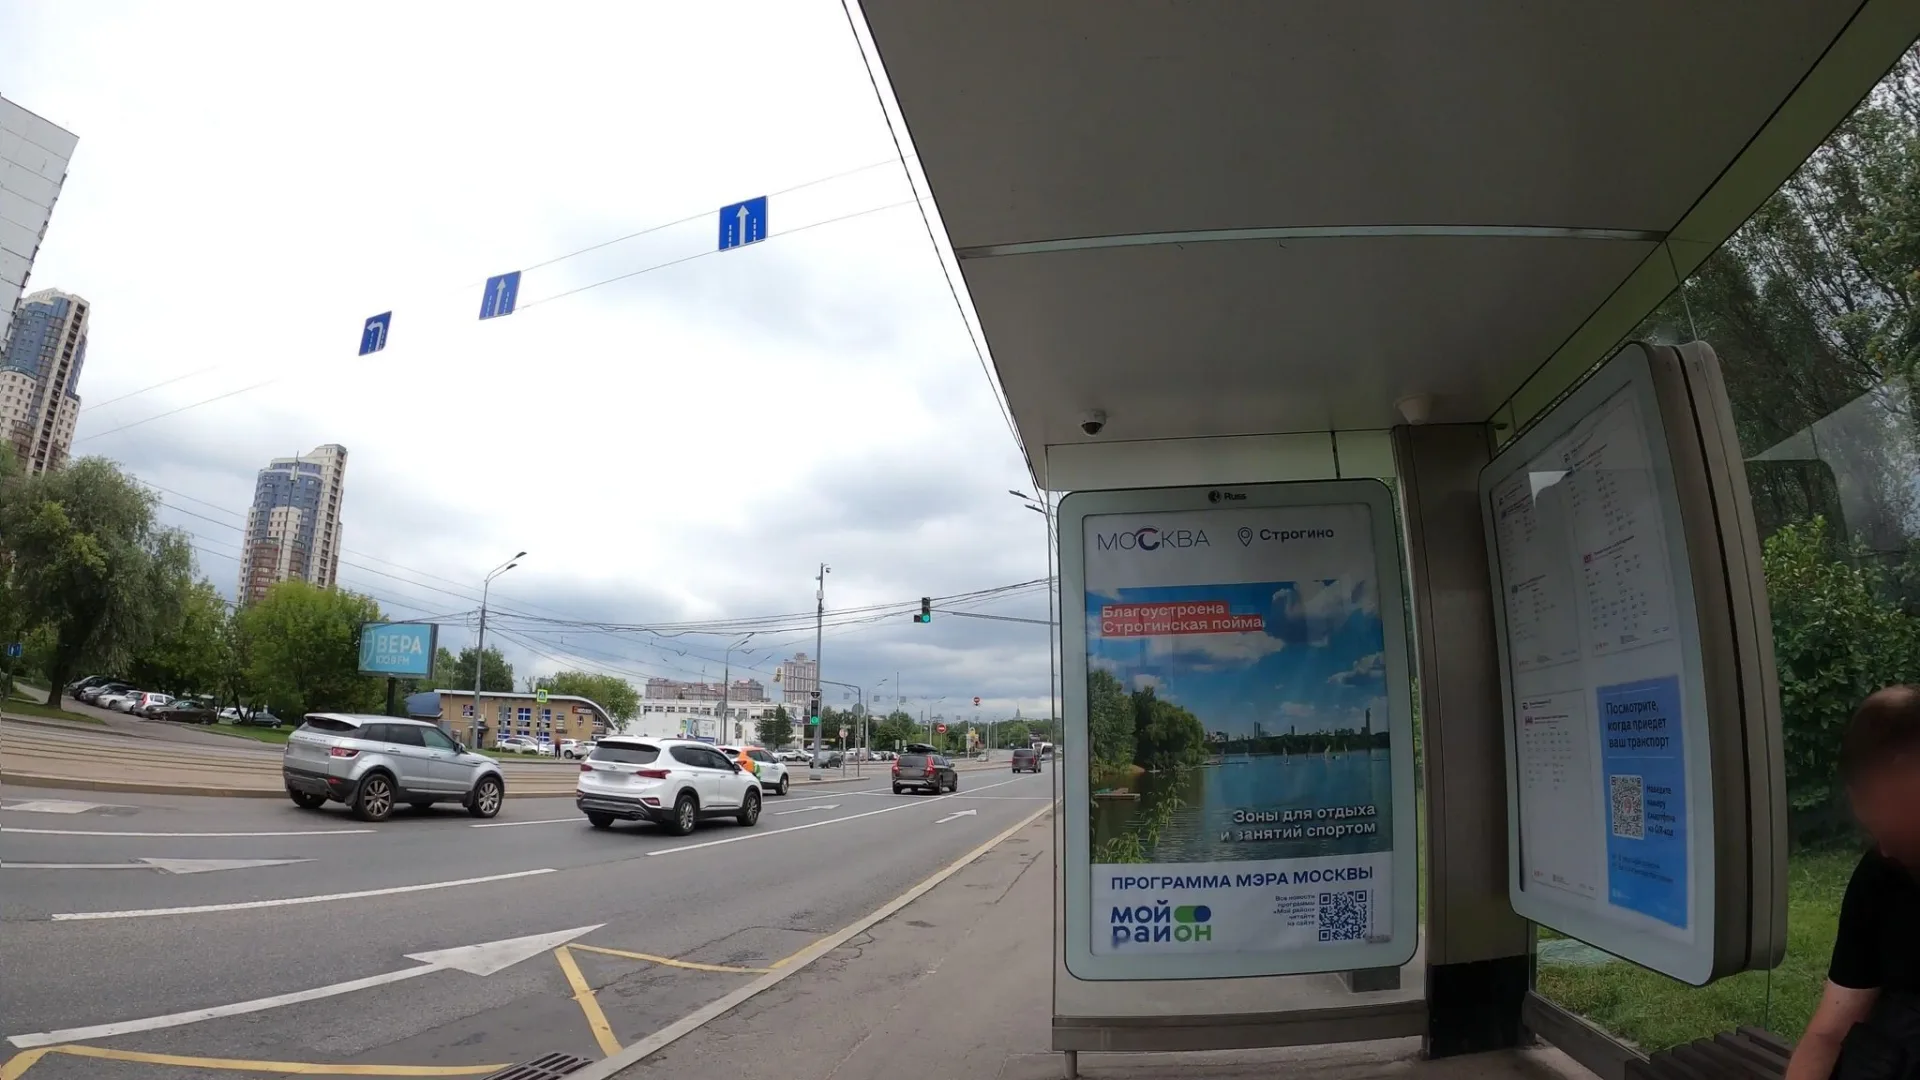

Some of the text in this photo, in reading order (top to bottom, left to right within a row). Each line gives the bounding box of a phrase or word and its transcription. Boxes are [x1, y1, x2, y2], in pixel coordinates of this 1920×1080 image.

[1097, 527, 1211, 551] МОСКВА
[1259, 529, 1334, 542] Строгино
[1102, 604, 1225, 619] Благоустроена
[1102, 619, 1208, 635] Строгинская
[377, 634, 422, 654] ВЕРА
[1605, 701, 1659, 715] Посмотрите,
[1607, 718, 1667, 732] когда приедет
[1609, 736, 1670, 750] ваш транспорт
[1233, 805, 1376, 823] Зоны для отдыха
[1220, 823, 1376, 841] и занятий спортом
[1111, 866, 1373, 890] ПРОГРАММА МЭРА МОСКВЫ
